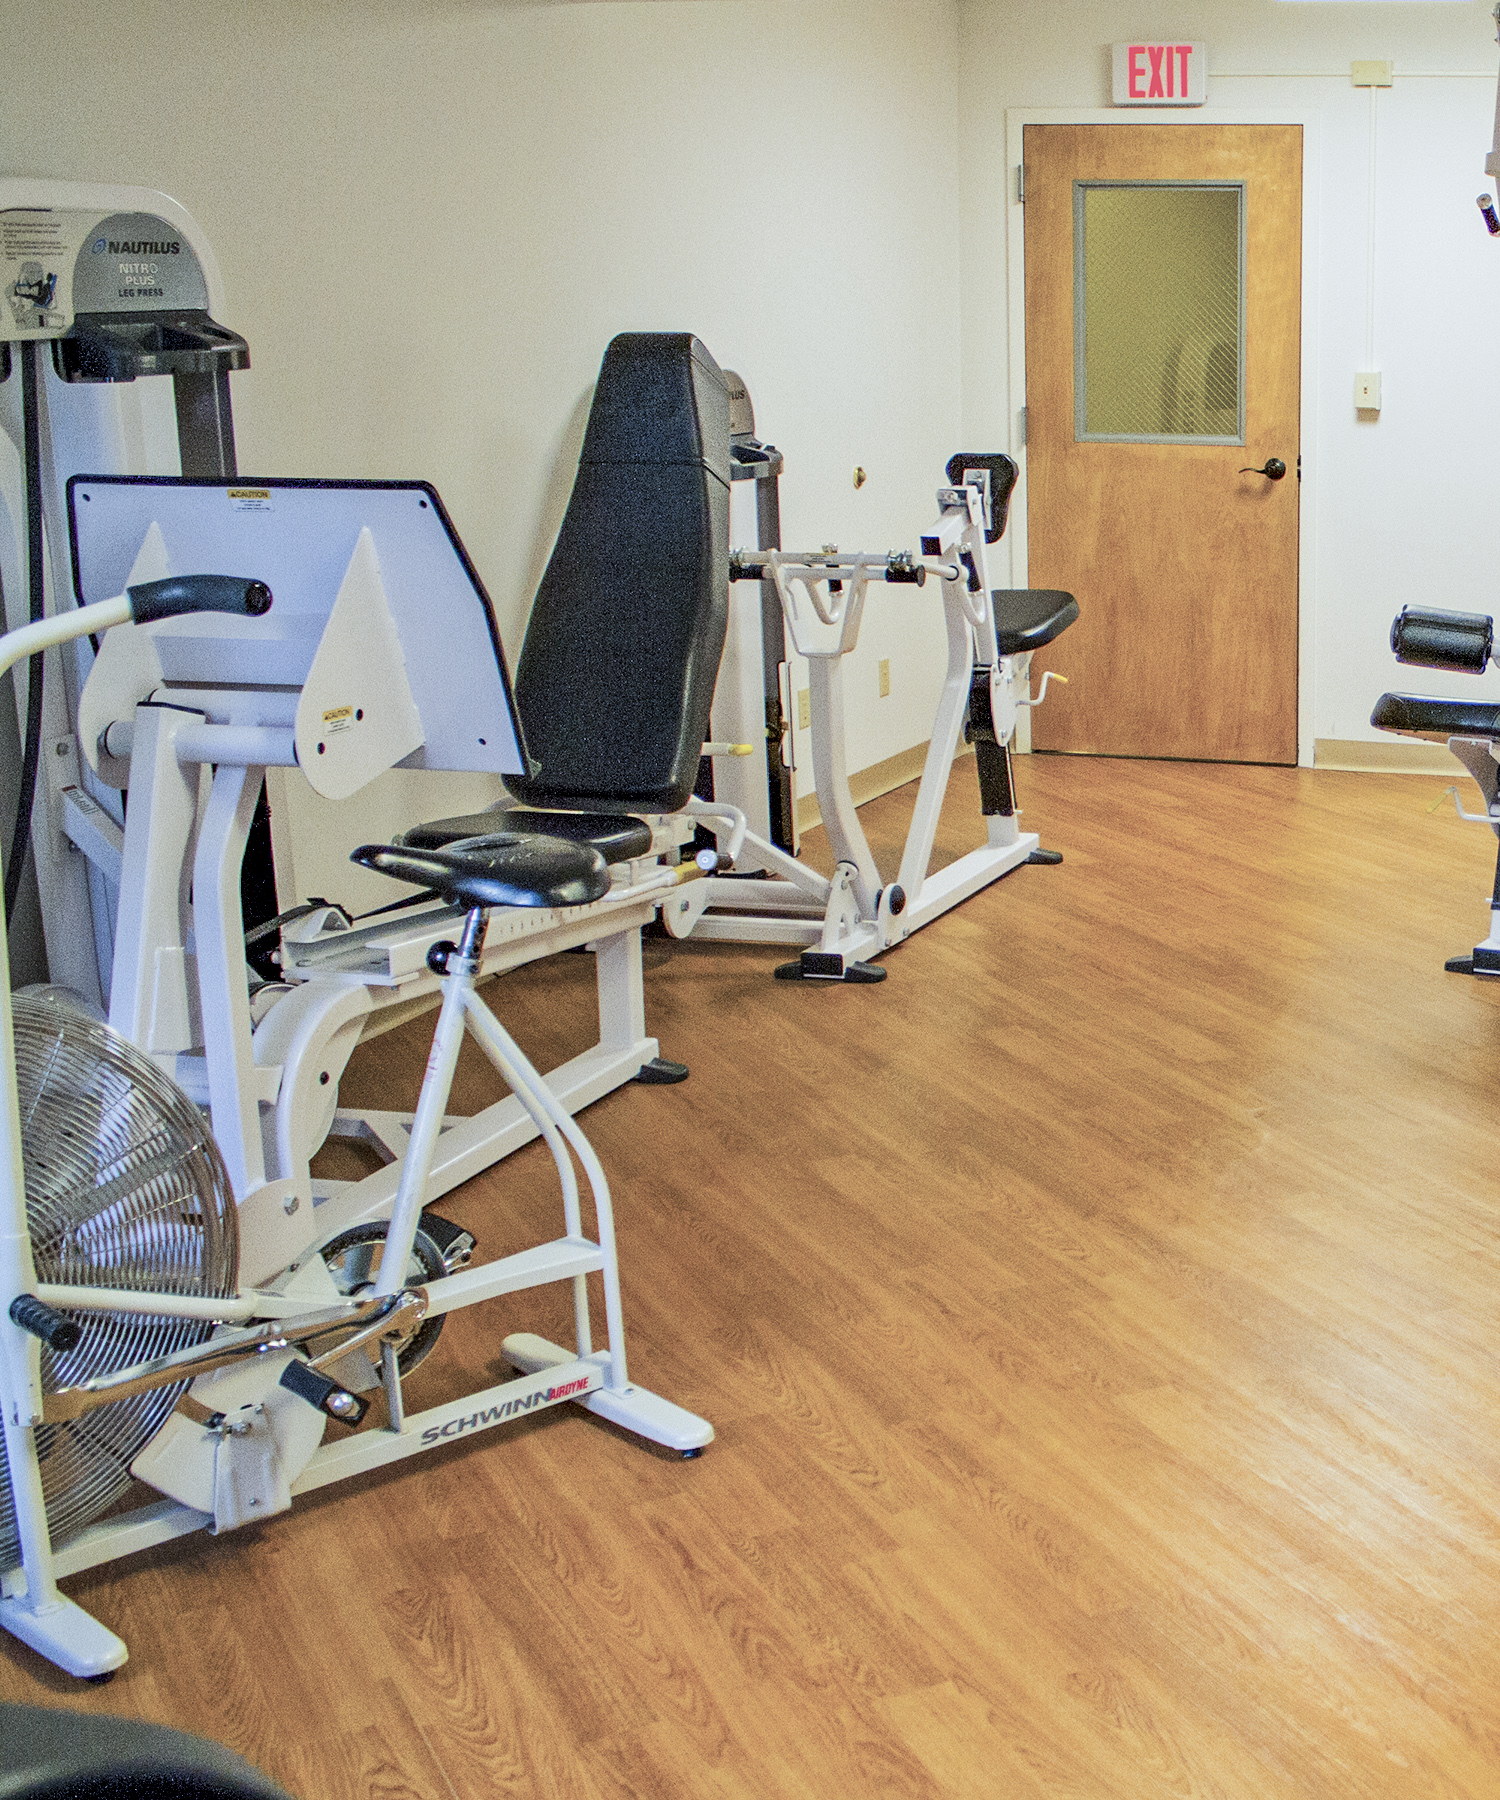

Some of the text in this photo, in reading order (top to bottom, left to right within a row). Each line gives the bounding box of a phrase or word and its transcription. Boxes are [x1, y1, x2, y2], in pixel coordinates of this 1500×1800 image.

[1128, 45, 1193, 98] EXIT
[108, 241, 180, 254] NAUTILUS
[119, 263, 159, 274] NITRO
[125, 275, 155, 286] PLUS
[118, 288, 164, 298] LEG PRESS
[420, 1376, 589, 1446] SCHWINN AIRDYNE
